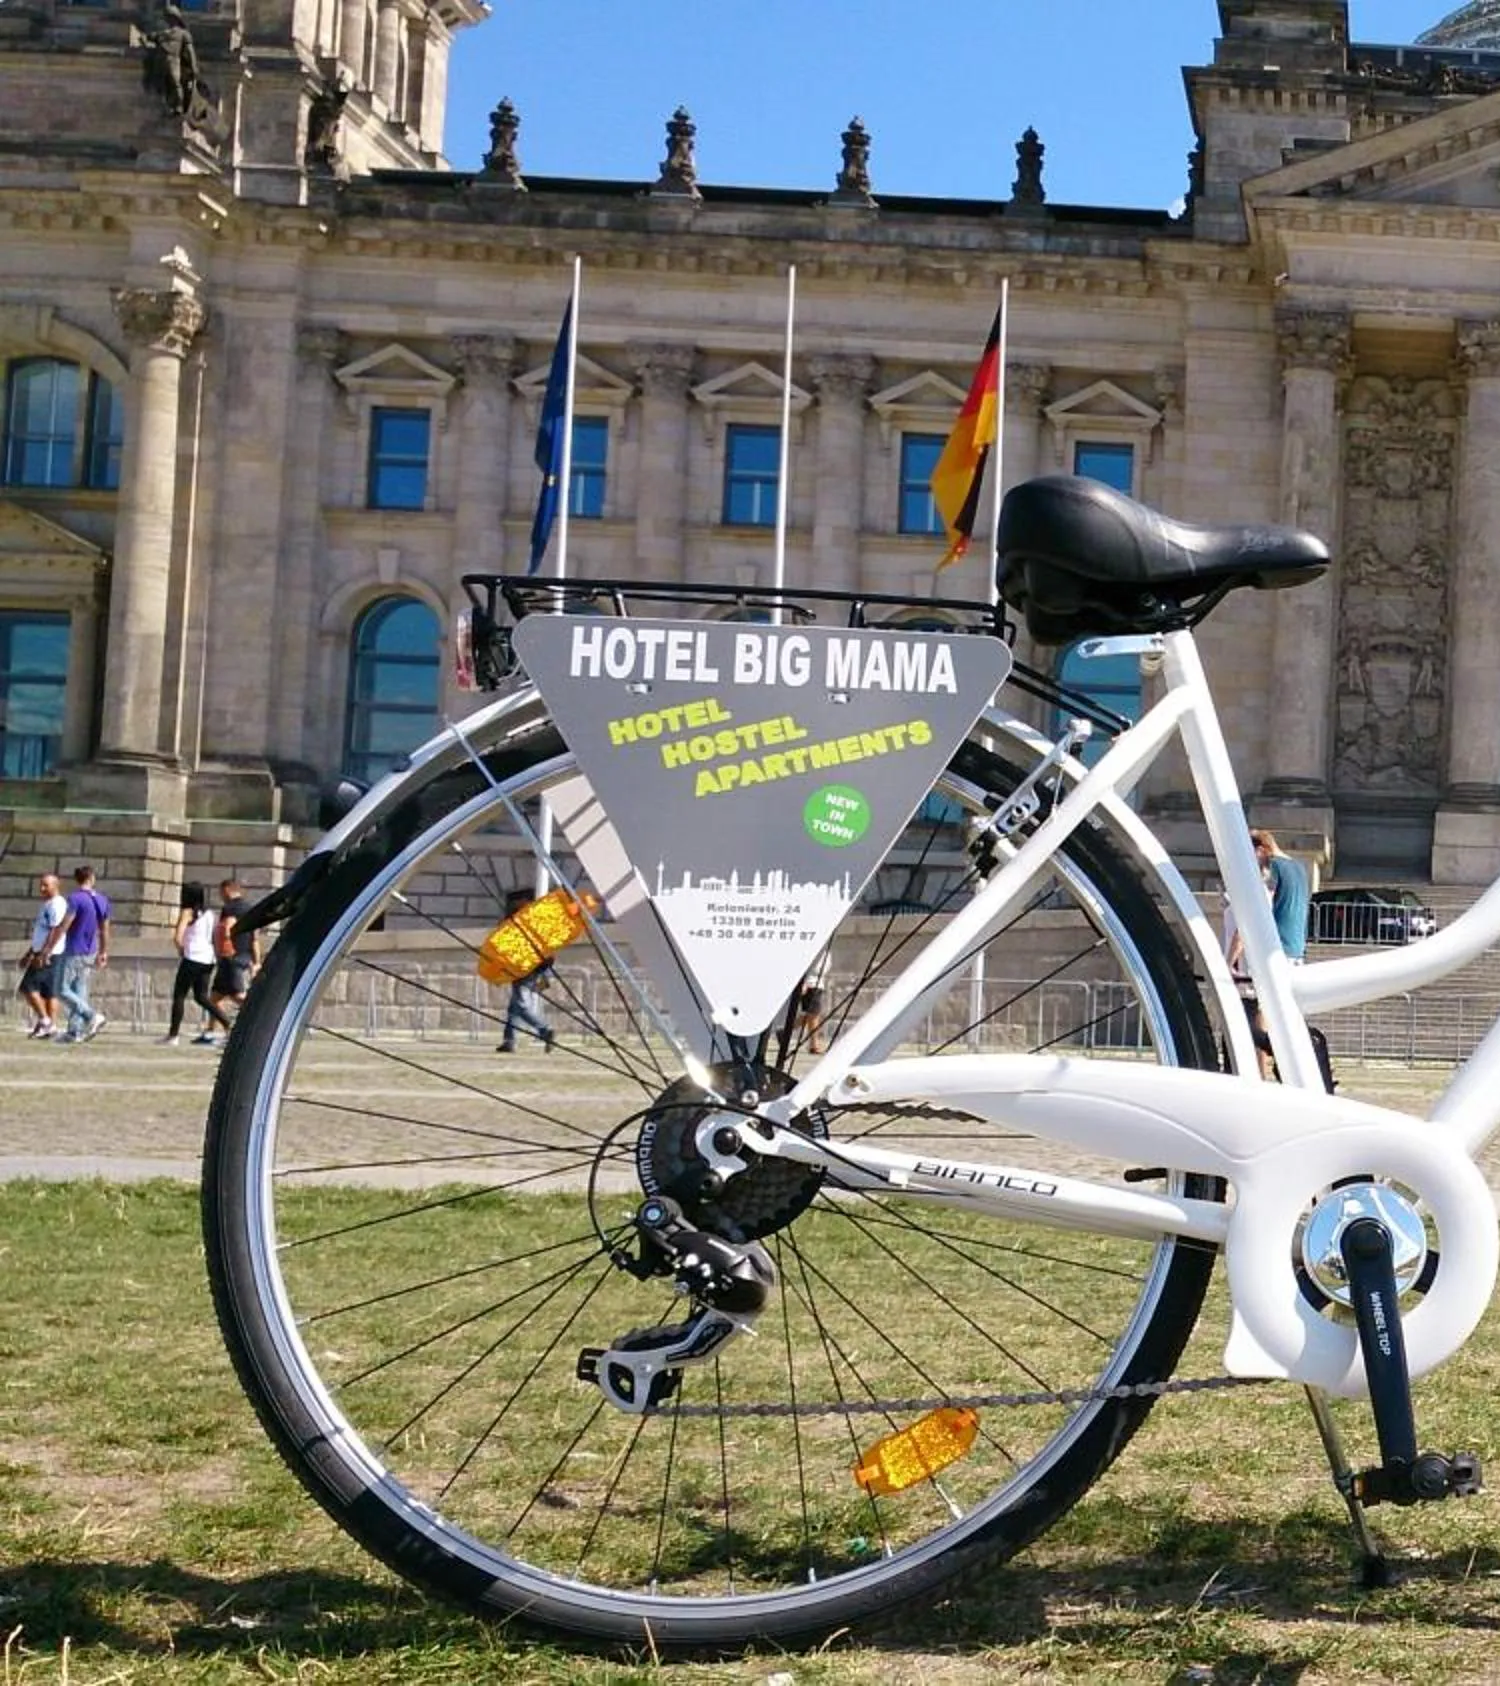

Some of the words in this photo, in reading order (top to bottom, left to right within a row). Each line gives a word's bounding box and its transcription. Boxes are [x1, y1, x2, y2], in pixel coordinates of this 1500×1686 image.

[570, 625, 719, 684] HOTEL
[733, 633, 811, 688] BIG
[825, 637, 958, 694] MAMA
[608, 698, 732, 745] HOTEL
[661, 716, 807, 769] HOSTEL
[695, 720, 933, 797] APARTMENTS
[825, 792, 860, 811] NEW
[829, 810, 845, 822] IN
[812, 819, 857, 841] TOWN
[688, 929, 713, 939] +49
[717, 929, 734, 939] 30
[755, 916, 796, 927] Berlin
[913, 1161, 1058, 1197] BIANCO
[1369, 1291, 1387, 1331] WHEEL
[1377, 1331, 1391, 1356] TOP
